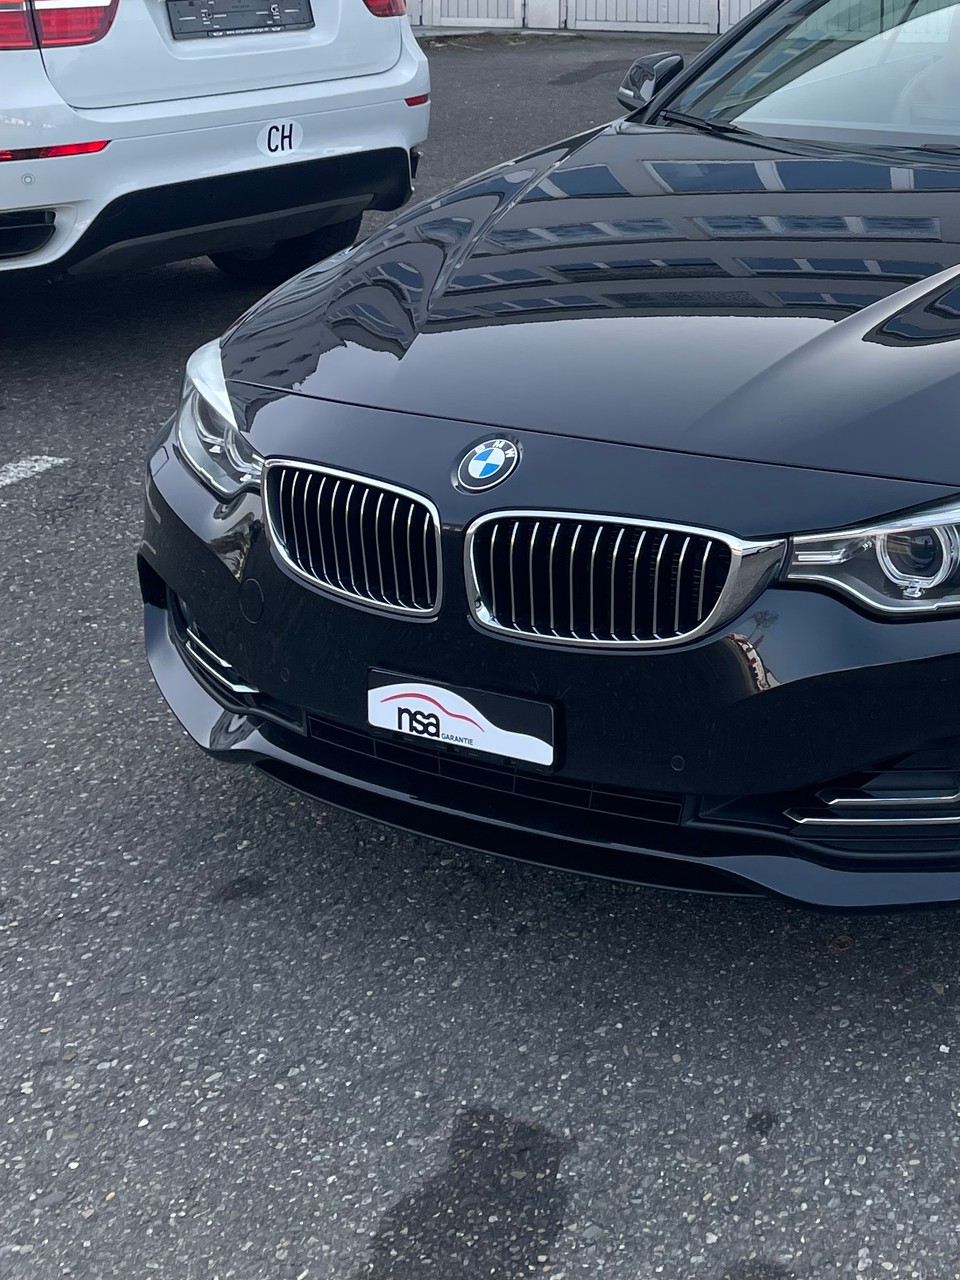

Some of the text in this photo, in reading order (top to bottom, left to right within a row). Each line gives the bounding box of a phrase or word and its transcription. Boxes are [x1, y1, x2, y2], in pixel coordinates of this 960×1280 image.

[267, 123, 294, 153] CH
[474, 440, 516, 459] BMW
[397, 706, 474, 746] nsa GARANTIE
